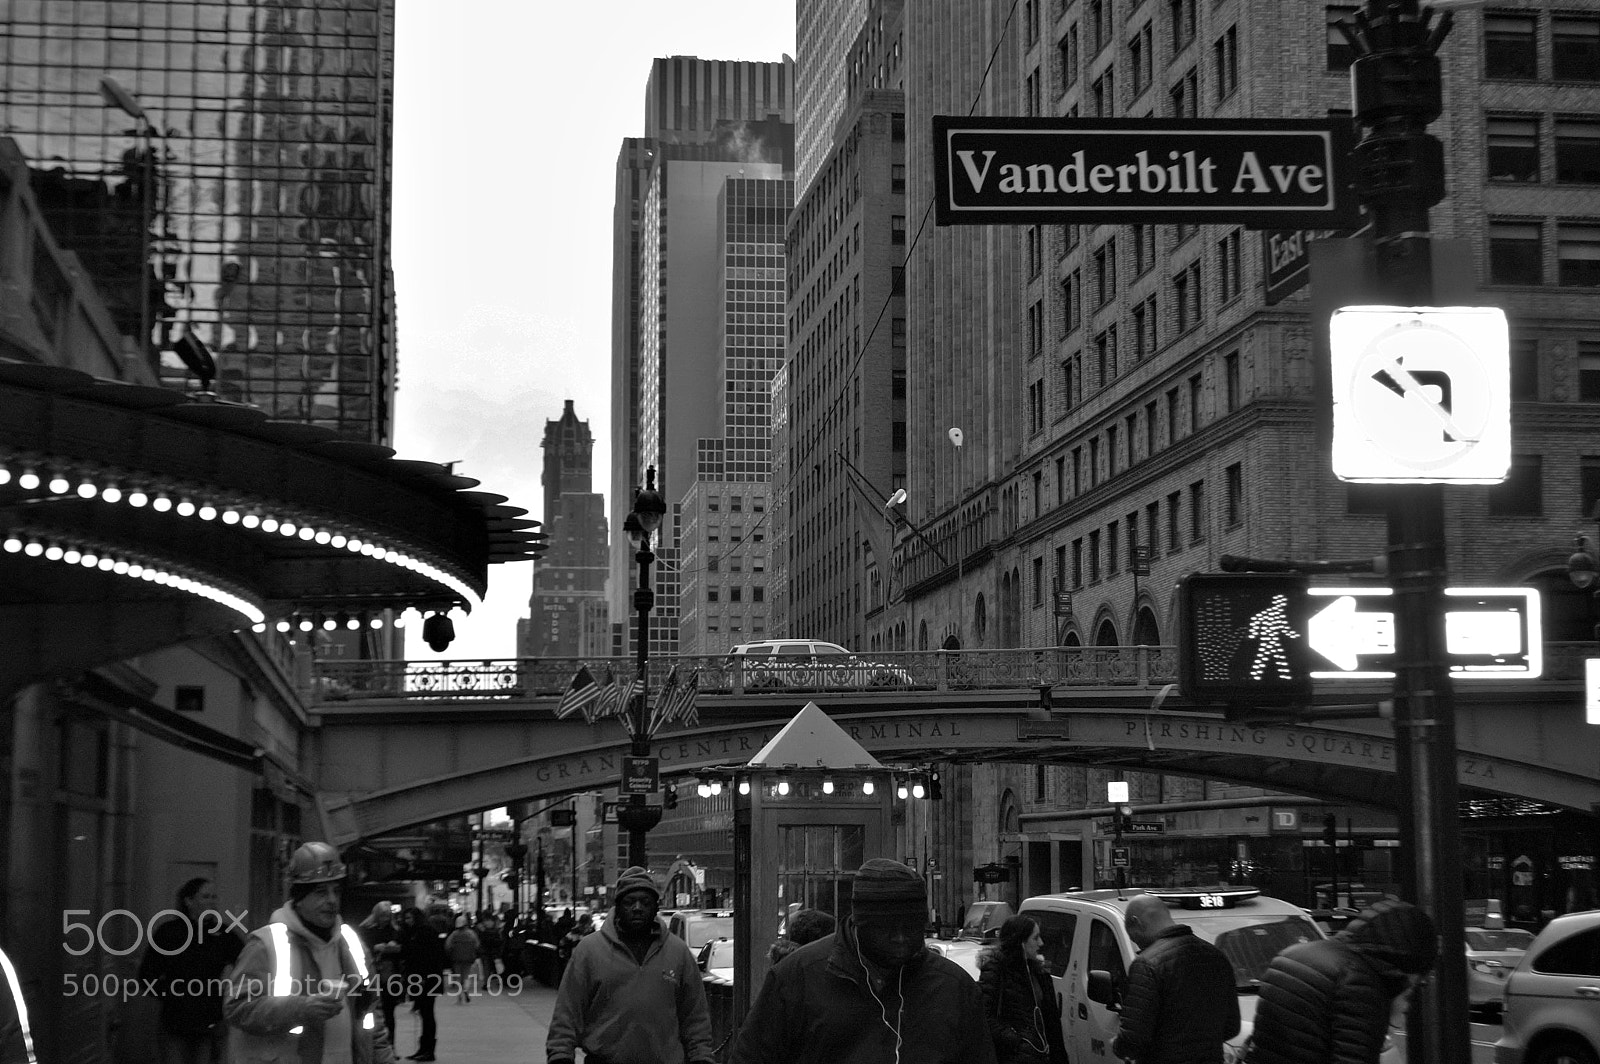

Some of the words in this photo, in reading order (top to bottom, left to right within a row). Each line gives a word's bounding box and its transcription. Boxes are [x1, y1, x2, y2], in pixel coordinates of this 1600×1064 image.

[956, 149, 1218, 196] Vanderbilt
[1232, 150, 1325, 196] Ave
[1269, 230, 1305, 274] East
[536, 754, 620, 782] GRAN
[659, 733, 770, 761] CENTRA
[1286, 733, 1395, 760] SQUARE
[1275, 812, 1295, 826] TD
[1199, 895, 1225, 908] 3E18
